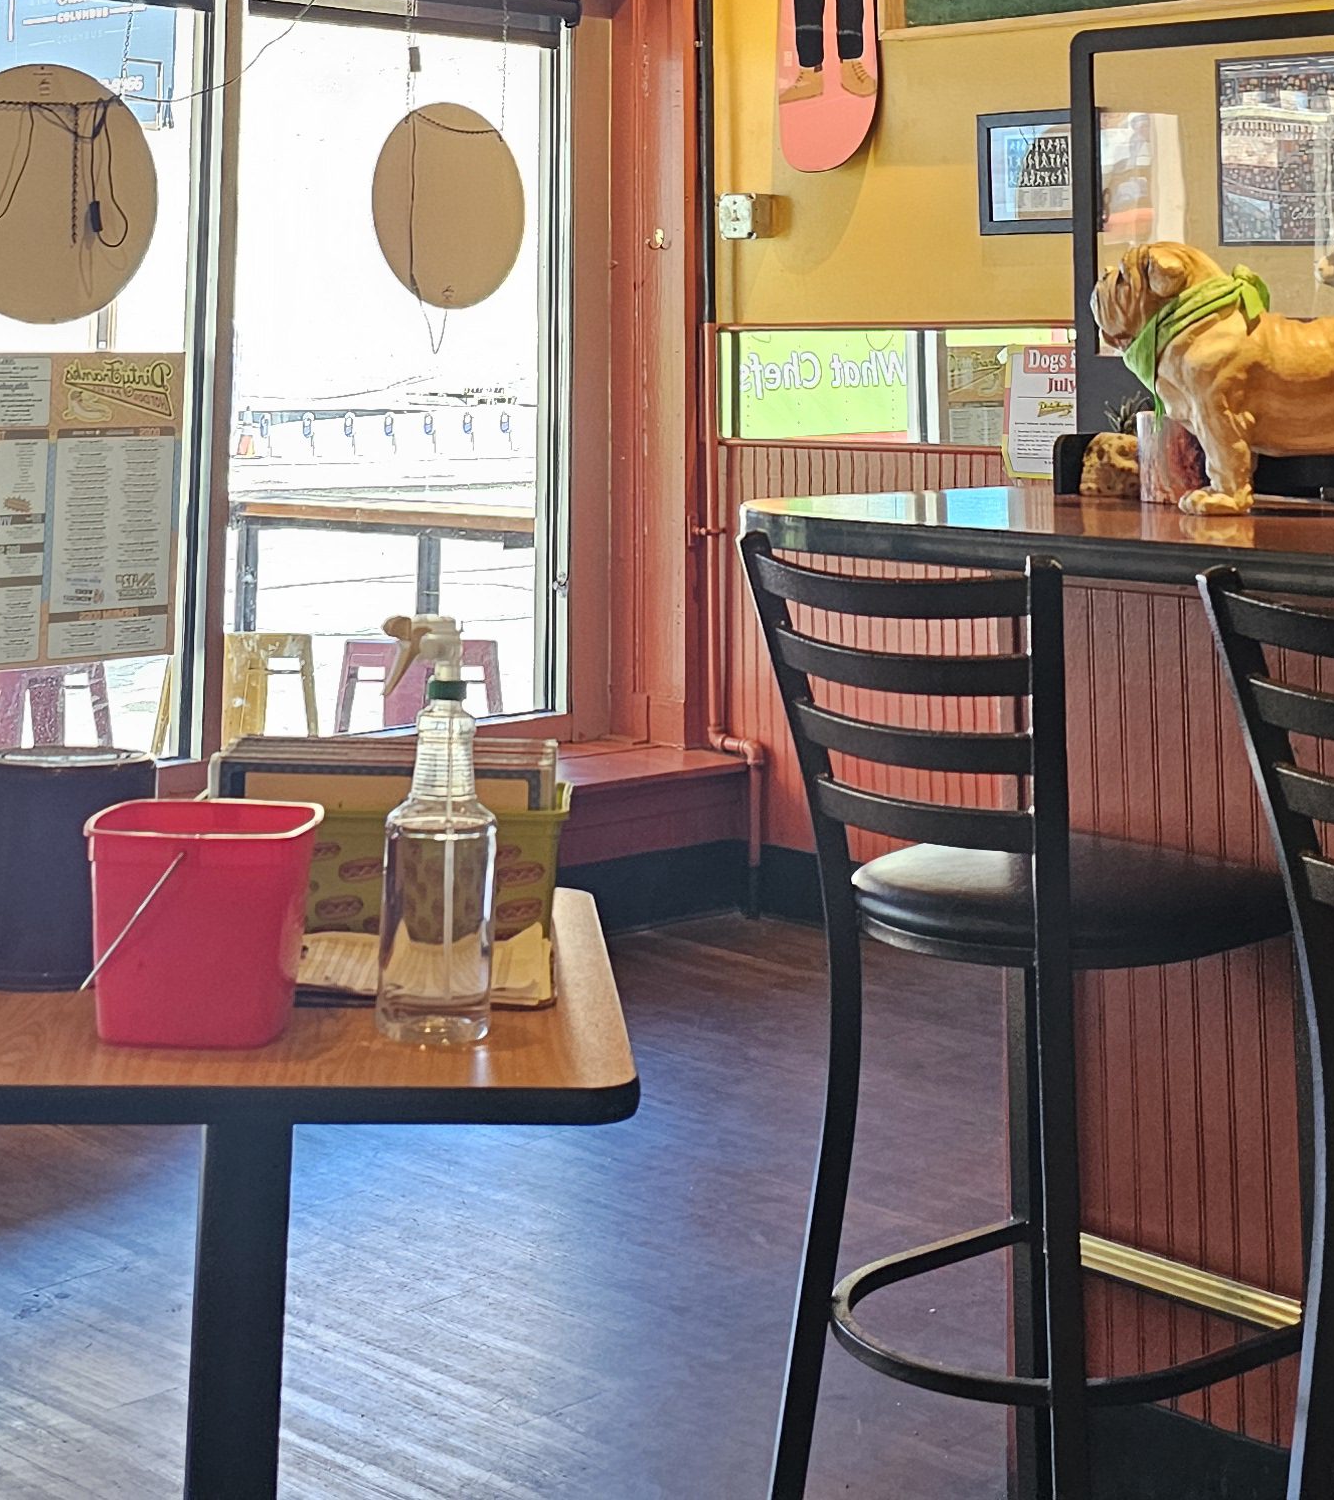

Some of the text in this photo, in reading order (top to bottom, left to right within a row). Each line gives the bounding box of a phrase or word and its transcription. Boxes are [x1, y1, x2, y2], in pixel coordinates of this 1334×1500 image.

[55, 6, 111, 24] COLUMBUS
[1027, 348, 1068, 374] Dogs
[1047, 376, 1076, 395] July
